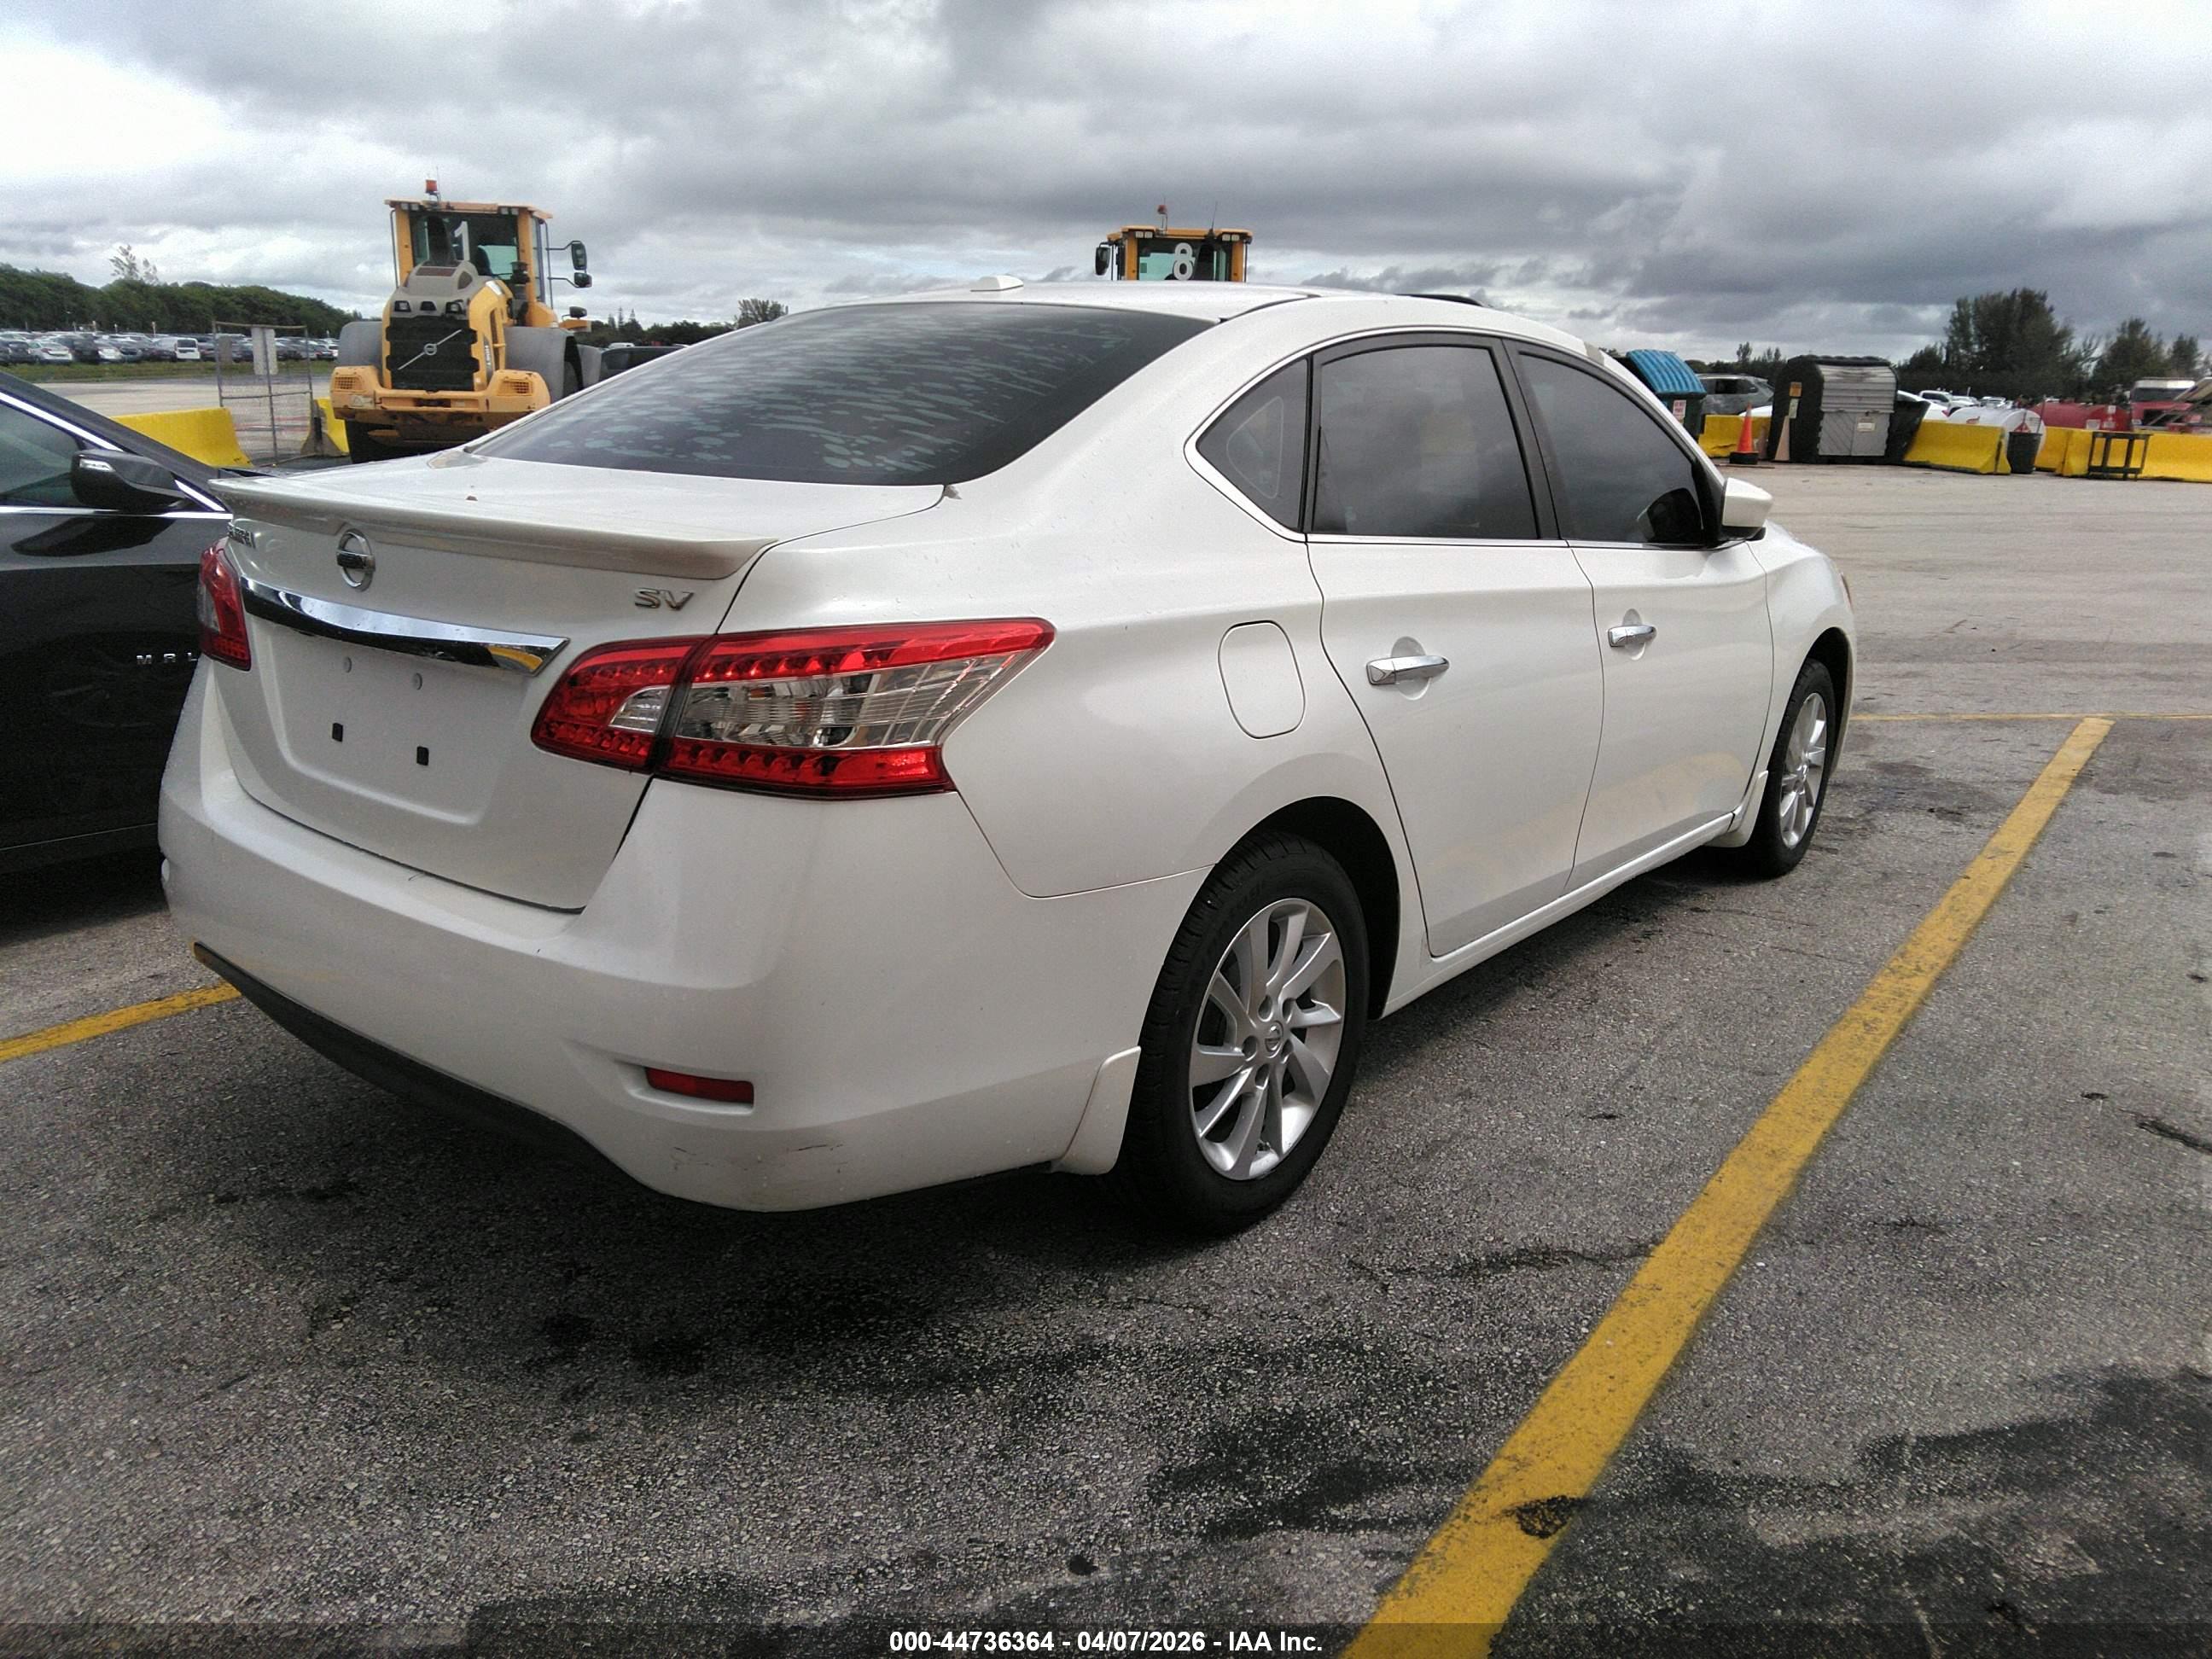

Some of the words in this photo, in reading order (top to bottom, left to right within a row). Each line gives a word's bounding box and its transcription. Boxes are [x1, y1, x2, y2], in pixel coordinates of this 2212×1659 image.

[453, 220, 471, 261] 1
[1173, 242, 1194, 281] 8
[634, 587, 695, 611] SV
